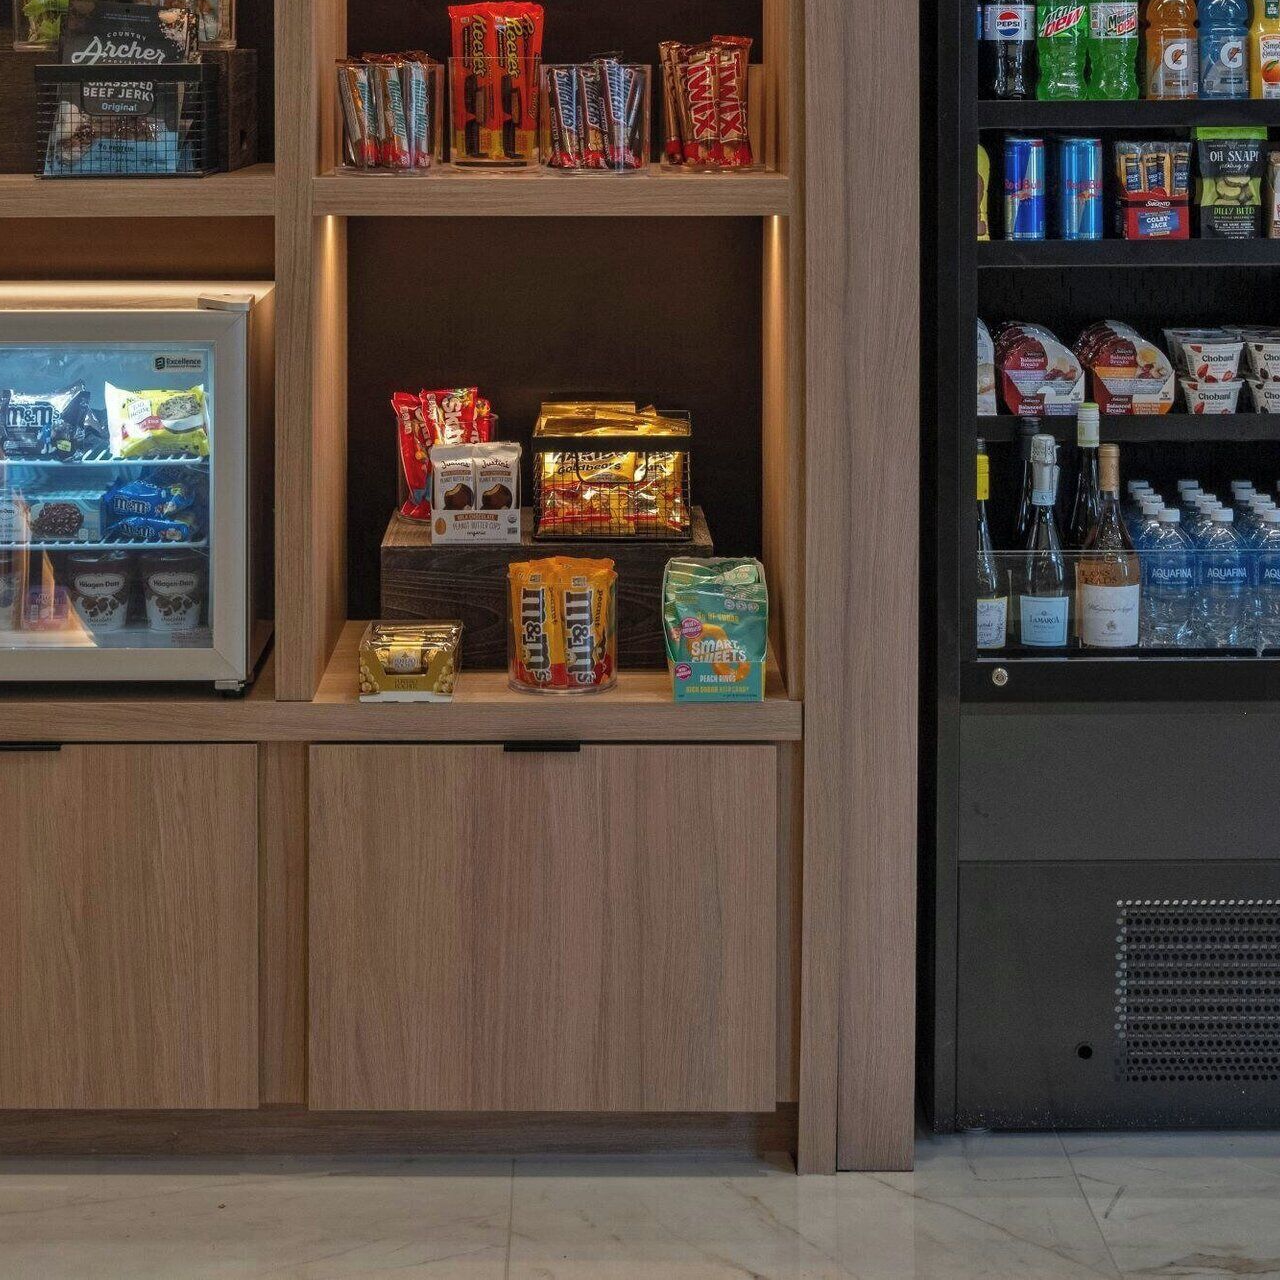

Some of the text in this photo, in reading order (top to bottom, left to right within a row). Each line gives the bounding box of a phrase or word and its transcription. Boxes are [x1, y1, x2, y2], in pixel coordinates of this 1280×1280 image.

[106, 30, 147, 40] COUNTRY
[71, 36, 166, 65] Archer
[1164, 43, 1188, 70] G
[1220, 41, 1243, 69] G
[83, 87, 115, 98] BEEF
[686, 53, 719, 140] TWIX
[719, 52, 743, 142] TWIX
[101, 103, 138, 113] Original
[1210, 150, 1259, 162] OH SNAP!
[1214, 207, 1233, 215] DILLY
[1202, 353, 1234, 362] Chobani
[1198, 391, 1231, 400] Chobani
[558, 462, 622, 475] Goldbears
[453, 521, 500, 530] PEANUT BUTTER CUPS
[1152, 568, 1192, 579] AQUAFINA
[1207, 567, 1247, 579] AQUAFINA
[595, 589, 604, 629] Peanut
[691, 639, 740, 656] SMART
[700, 675, 718, 683] PEACH
